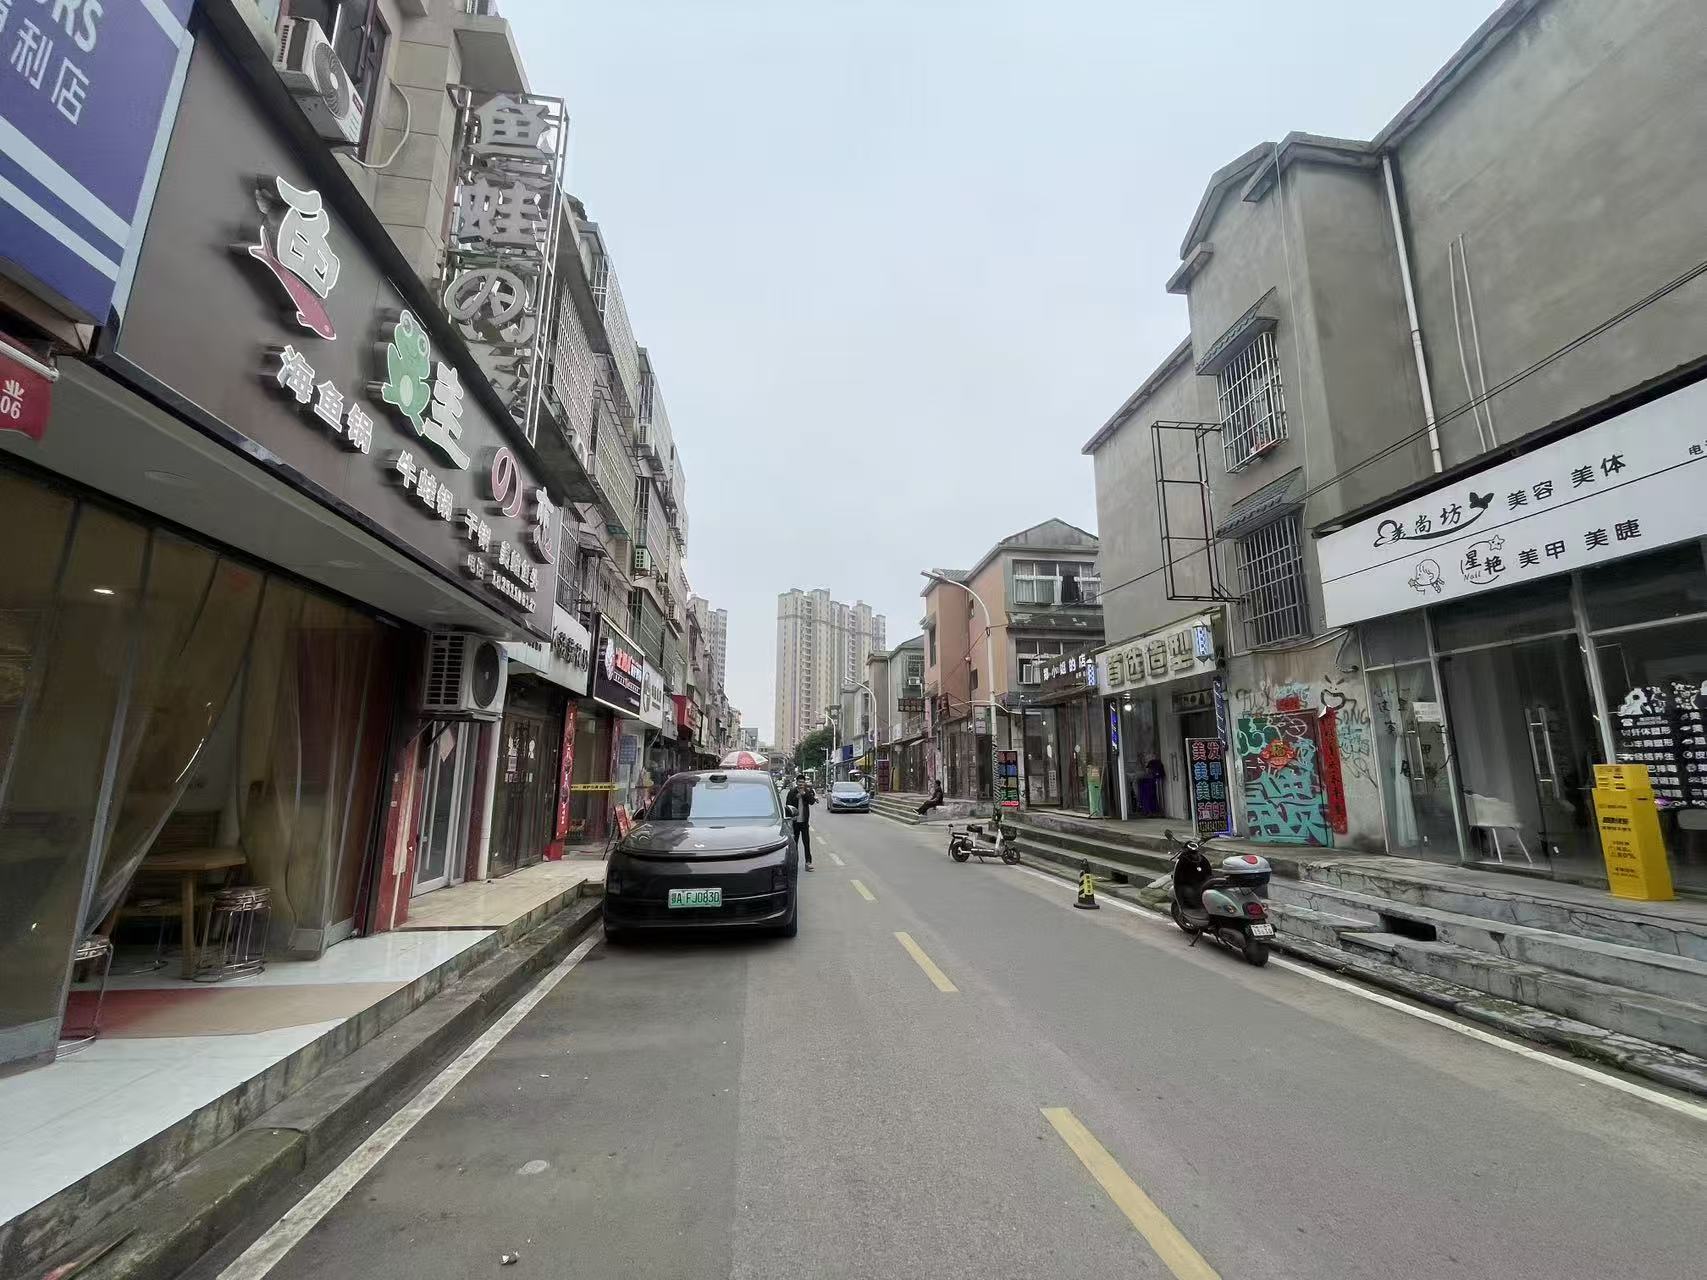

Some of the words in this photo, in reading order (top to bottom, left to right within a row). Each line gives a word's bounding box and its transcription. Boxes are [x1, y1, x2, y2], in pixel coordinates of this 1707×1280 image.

[2, 379, 25, 401] 业
[1689, 440, 1707, 455] 电
[396, 449, 454, 522] 牛蛙锅
[1507, 480, 1554, 511] 美容
[1571, 454, 1627, 488] 美体
[1465, 550, 1505, 575] 星艳
[1519, 542, 1567, 568] 美甲
[1585, 518, 1642, 550] 美睫
[1192, 741, 1221, 760] 美发
[1194, 761, 1222, 781] 美甲
